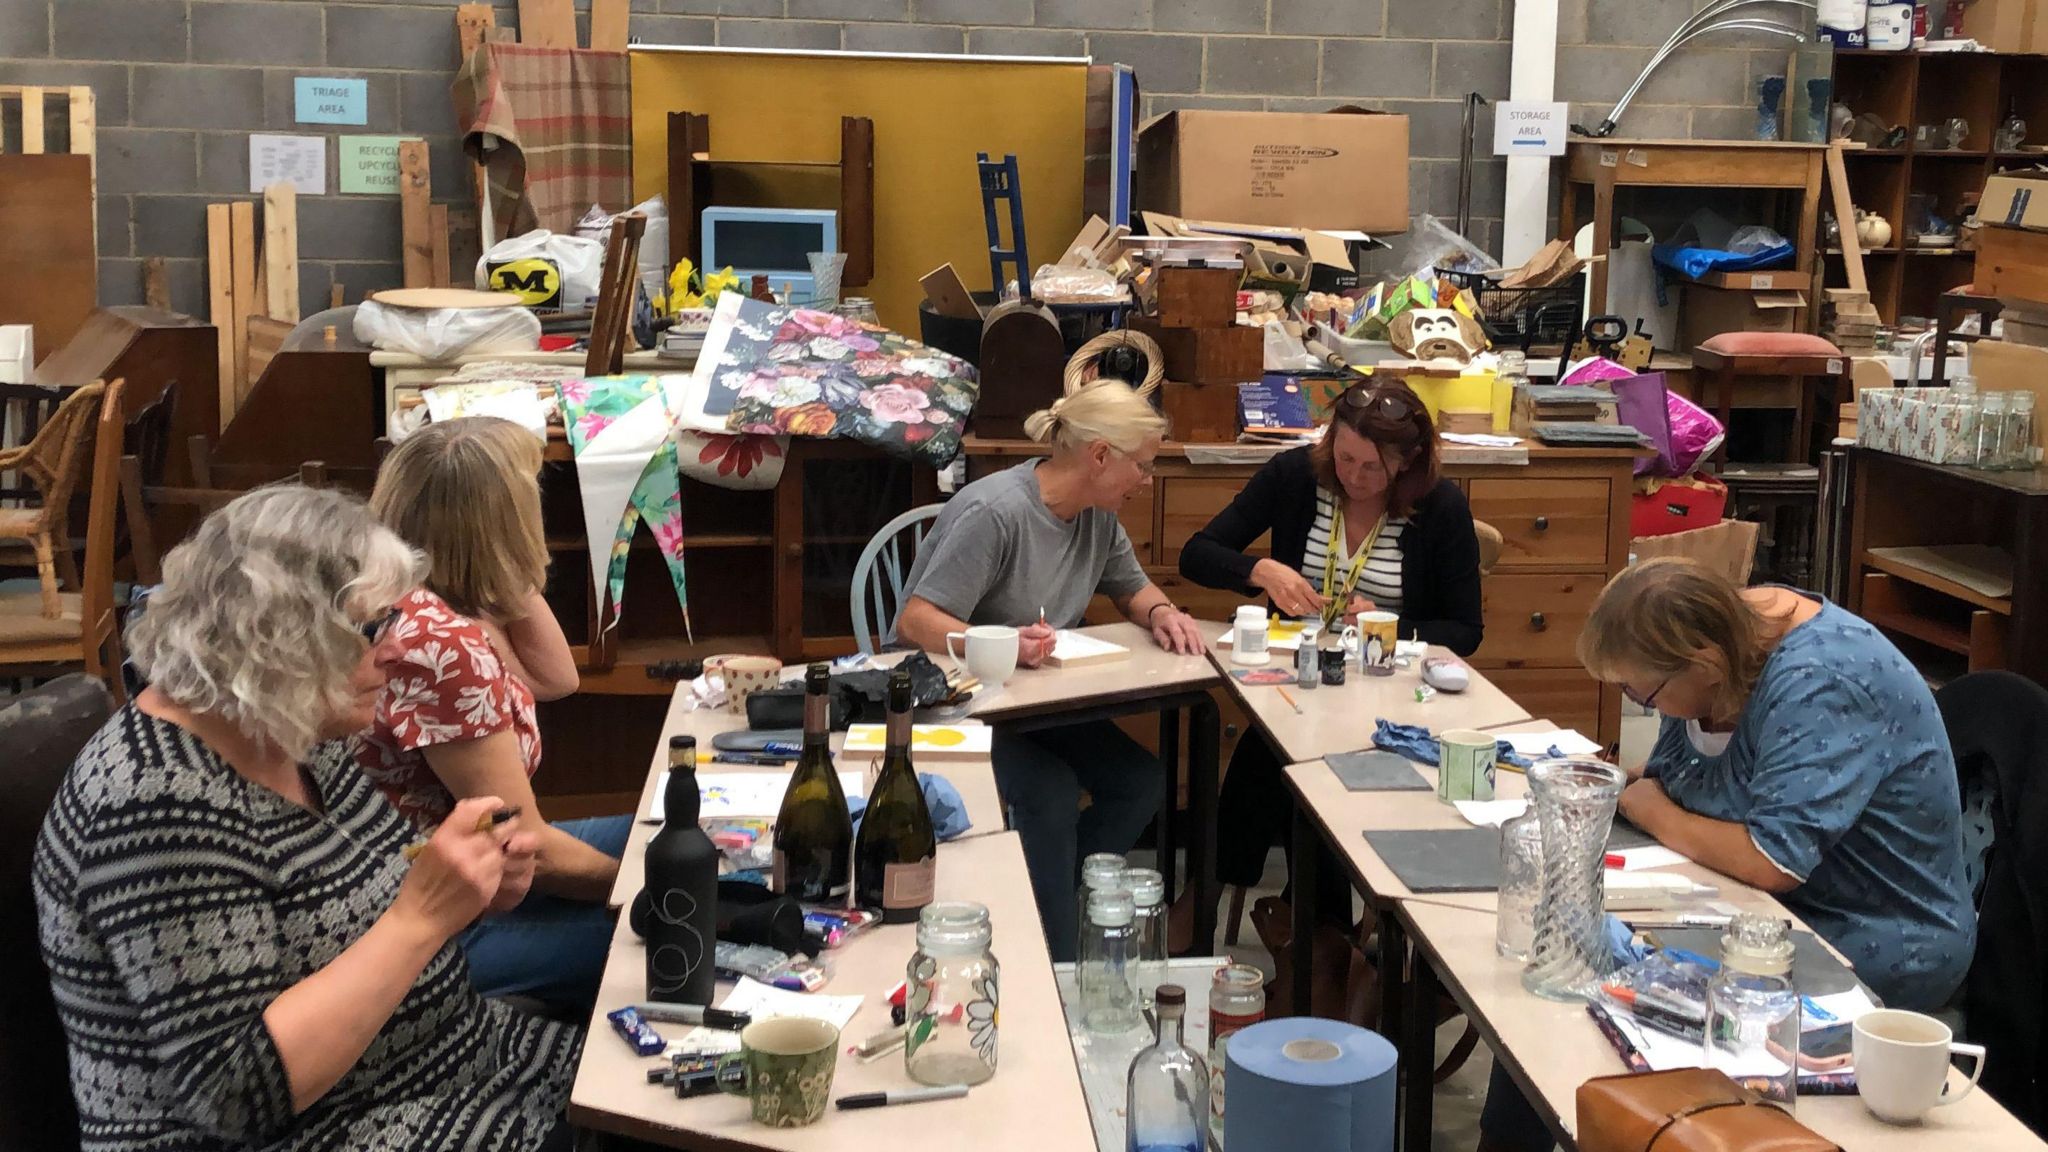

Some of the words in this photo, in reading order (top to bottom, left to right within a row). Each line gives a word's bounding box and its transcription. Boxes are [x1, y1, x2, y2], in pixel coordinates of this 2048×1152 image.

[312, 87, 349, 97] TRIAGE
[317, 105, 345, 114] AREA
[1509, 111, 1551, 121] STORAGE
[1518, 126, 1542, 136] AREA
[359, 146, 399, 156] RECYCL
[359, 160, 399, 170] UPCYCL
[365, 176, 398, 185] REUSE
[498, 270, 549, 293] M
